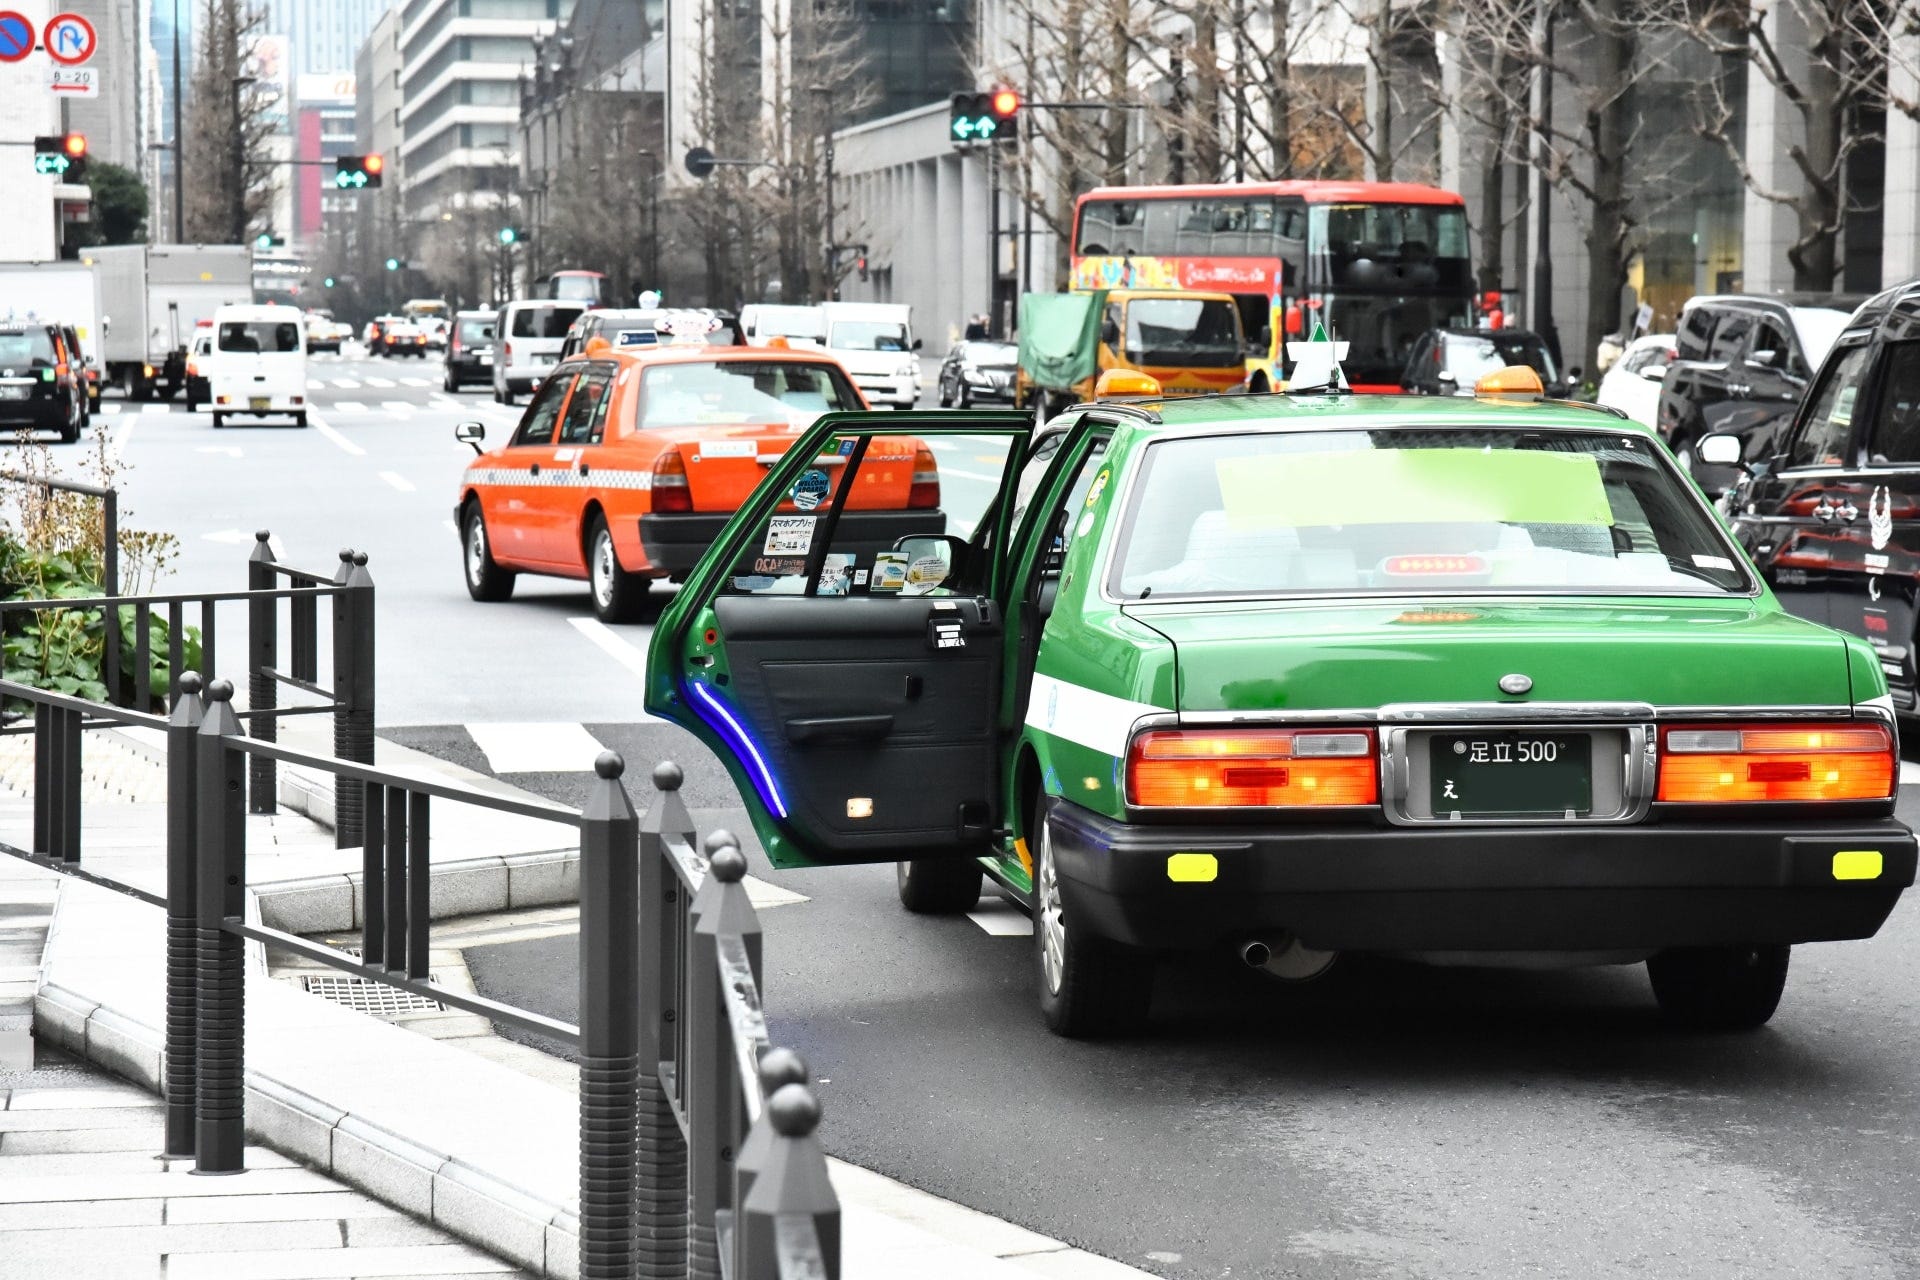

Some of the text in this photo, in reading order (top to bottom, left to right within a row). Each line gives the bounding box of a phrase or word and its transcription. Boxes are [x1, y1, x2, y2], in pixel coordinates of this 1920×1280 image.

[1621, 438, 1635, 449] 2
[1469, 741, 1557, 763] 足立 500
[1443, 779, 1459, 799] え
